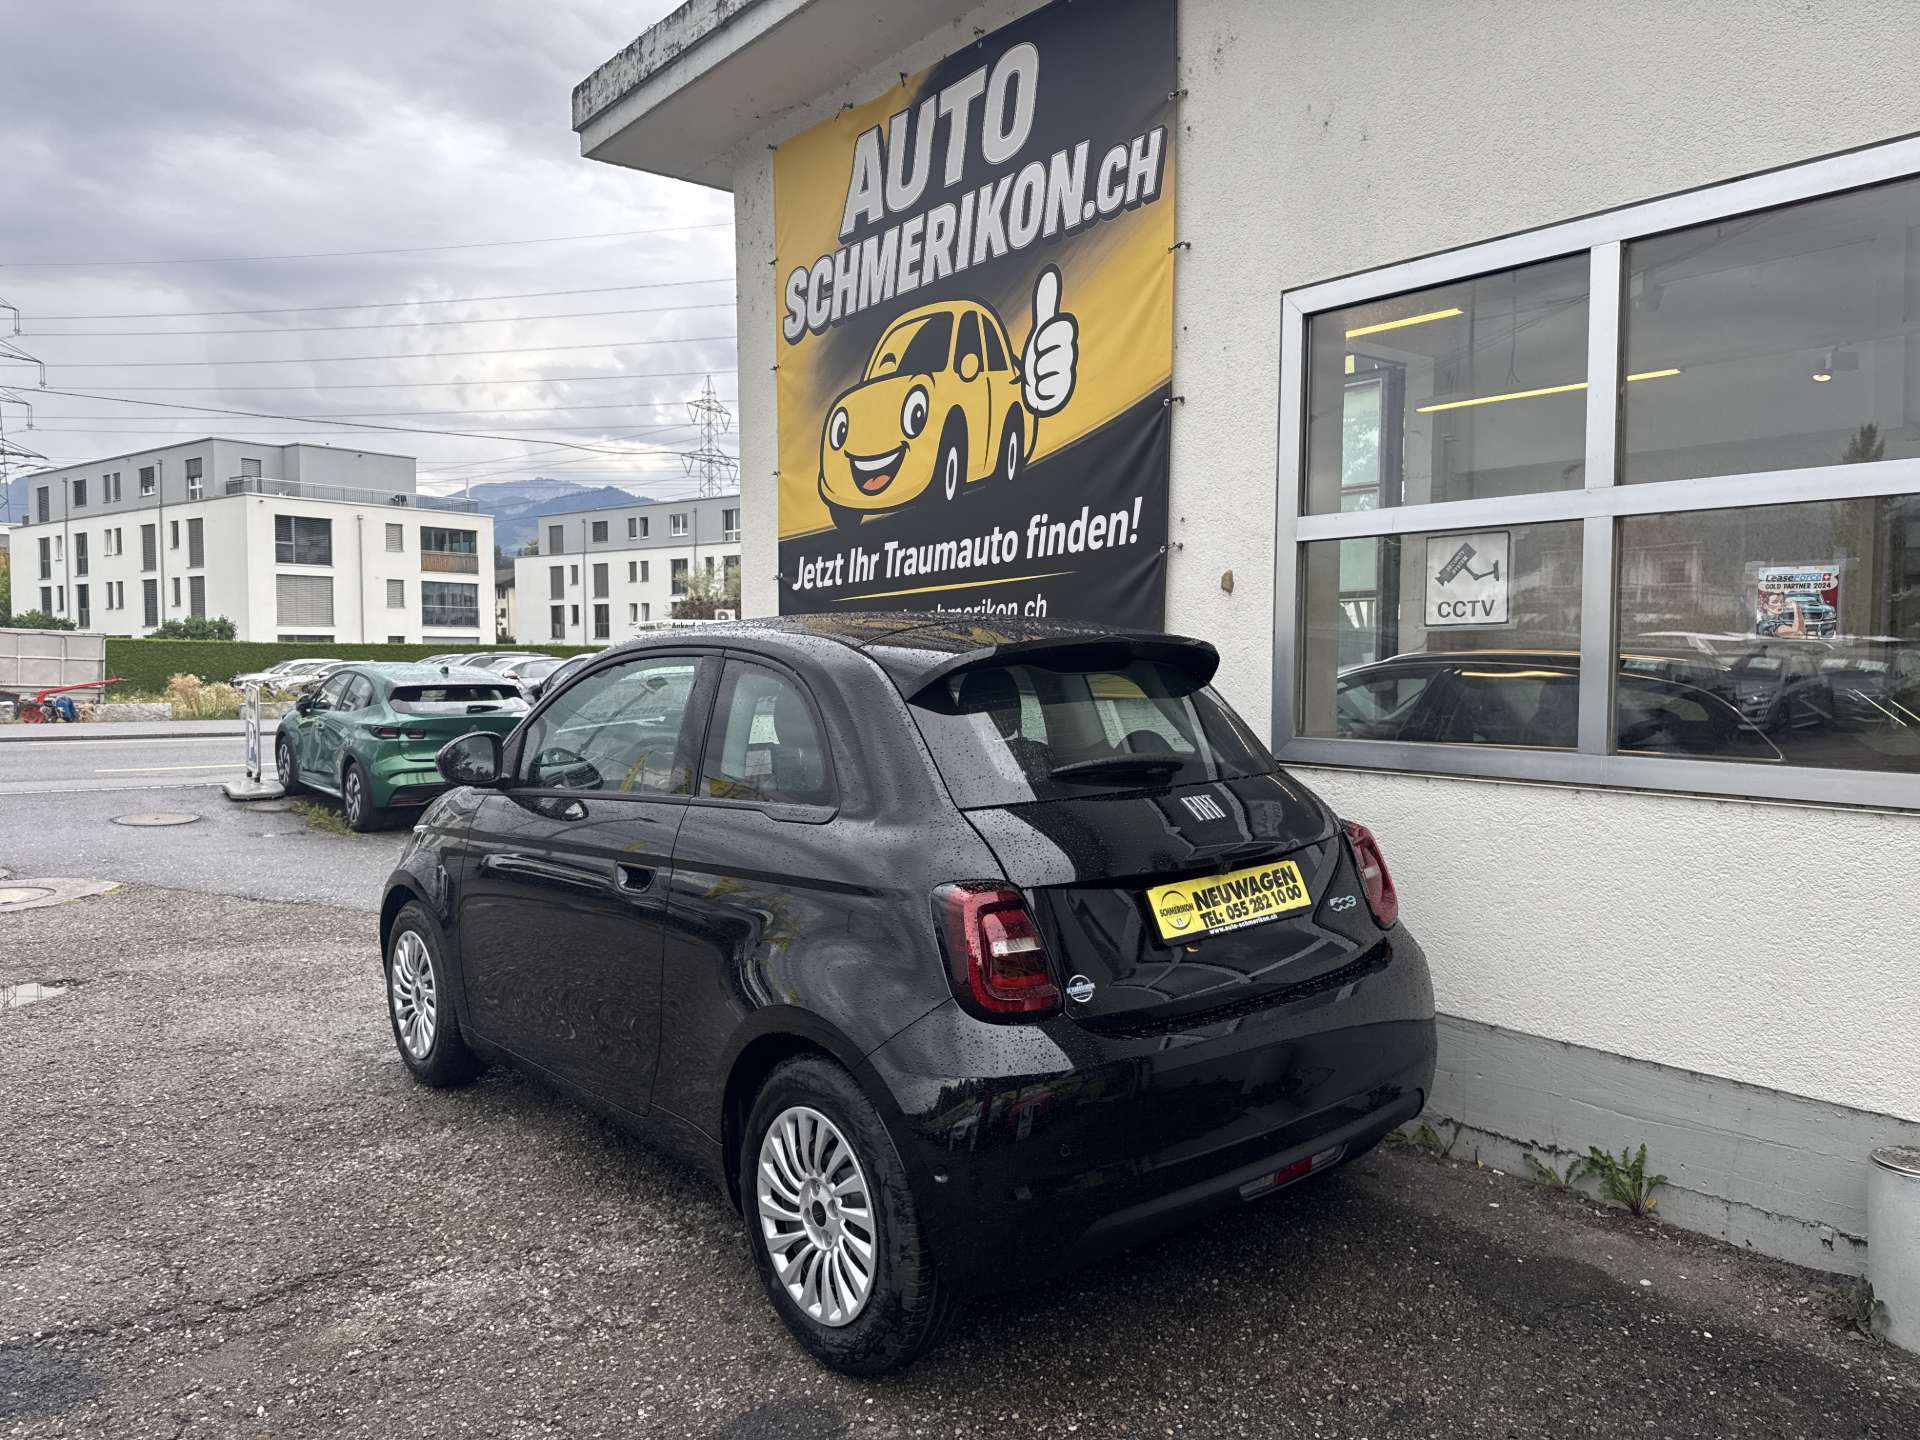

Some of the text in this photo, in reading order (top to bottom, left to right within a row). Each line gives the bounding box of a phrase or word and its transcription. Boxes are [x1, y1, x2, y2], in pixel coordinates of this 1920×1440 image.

[838, 41, 1040, 239] AUTO
[782, 127, 1165, 342] SCHMERIKON.CH
[792, 496, 1143, 591] Jetzt Ihr Traumauto finden!
[1813, 581, 1832, 589] 2024
[1437, 599, 1495, 618] CCTV
[1180, 794, 1227, 821] FIAT
[1192, 865, 1297, 912] NEUWAGEN
[1200, 884, 1302, 929] TEL: 055 282 10 00
